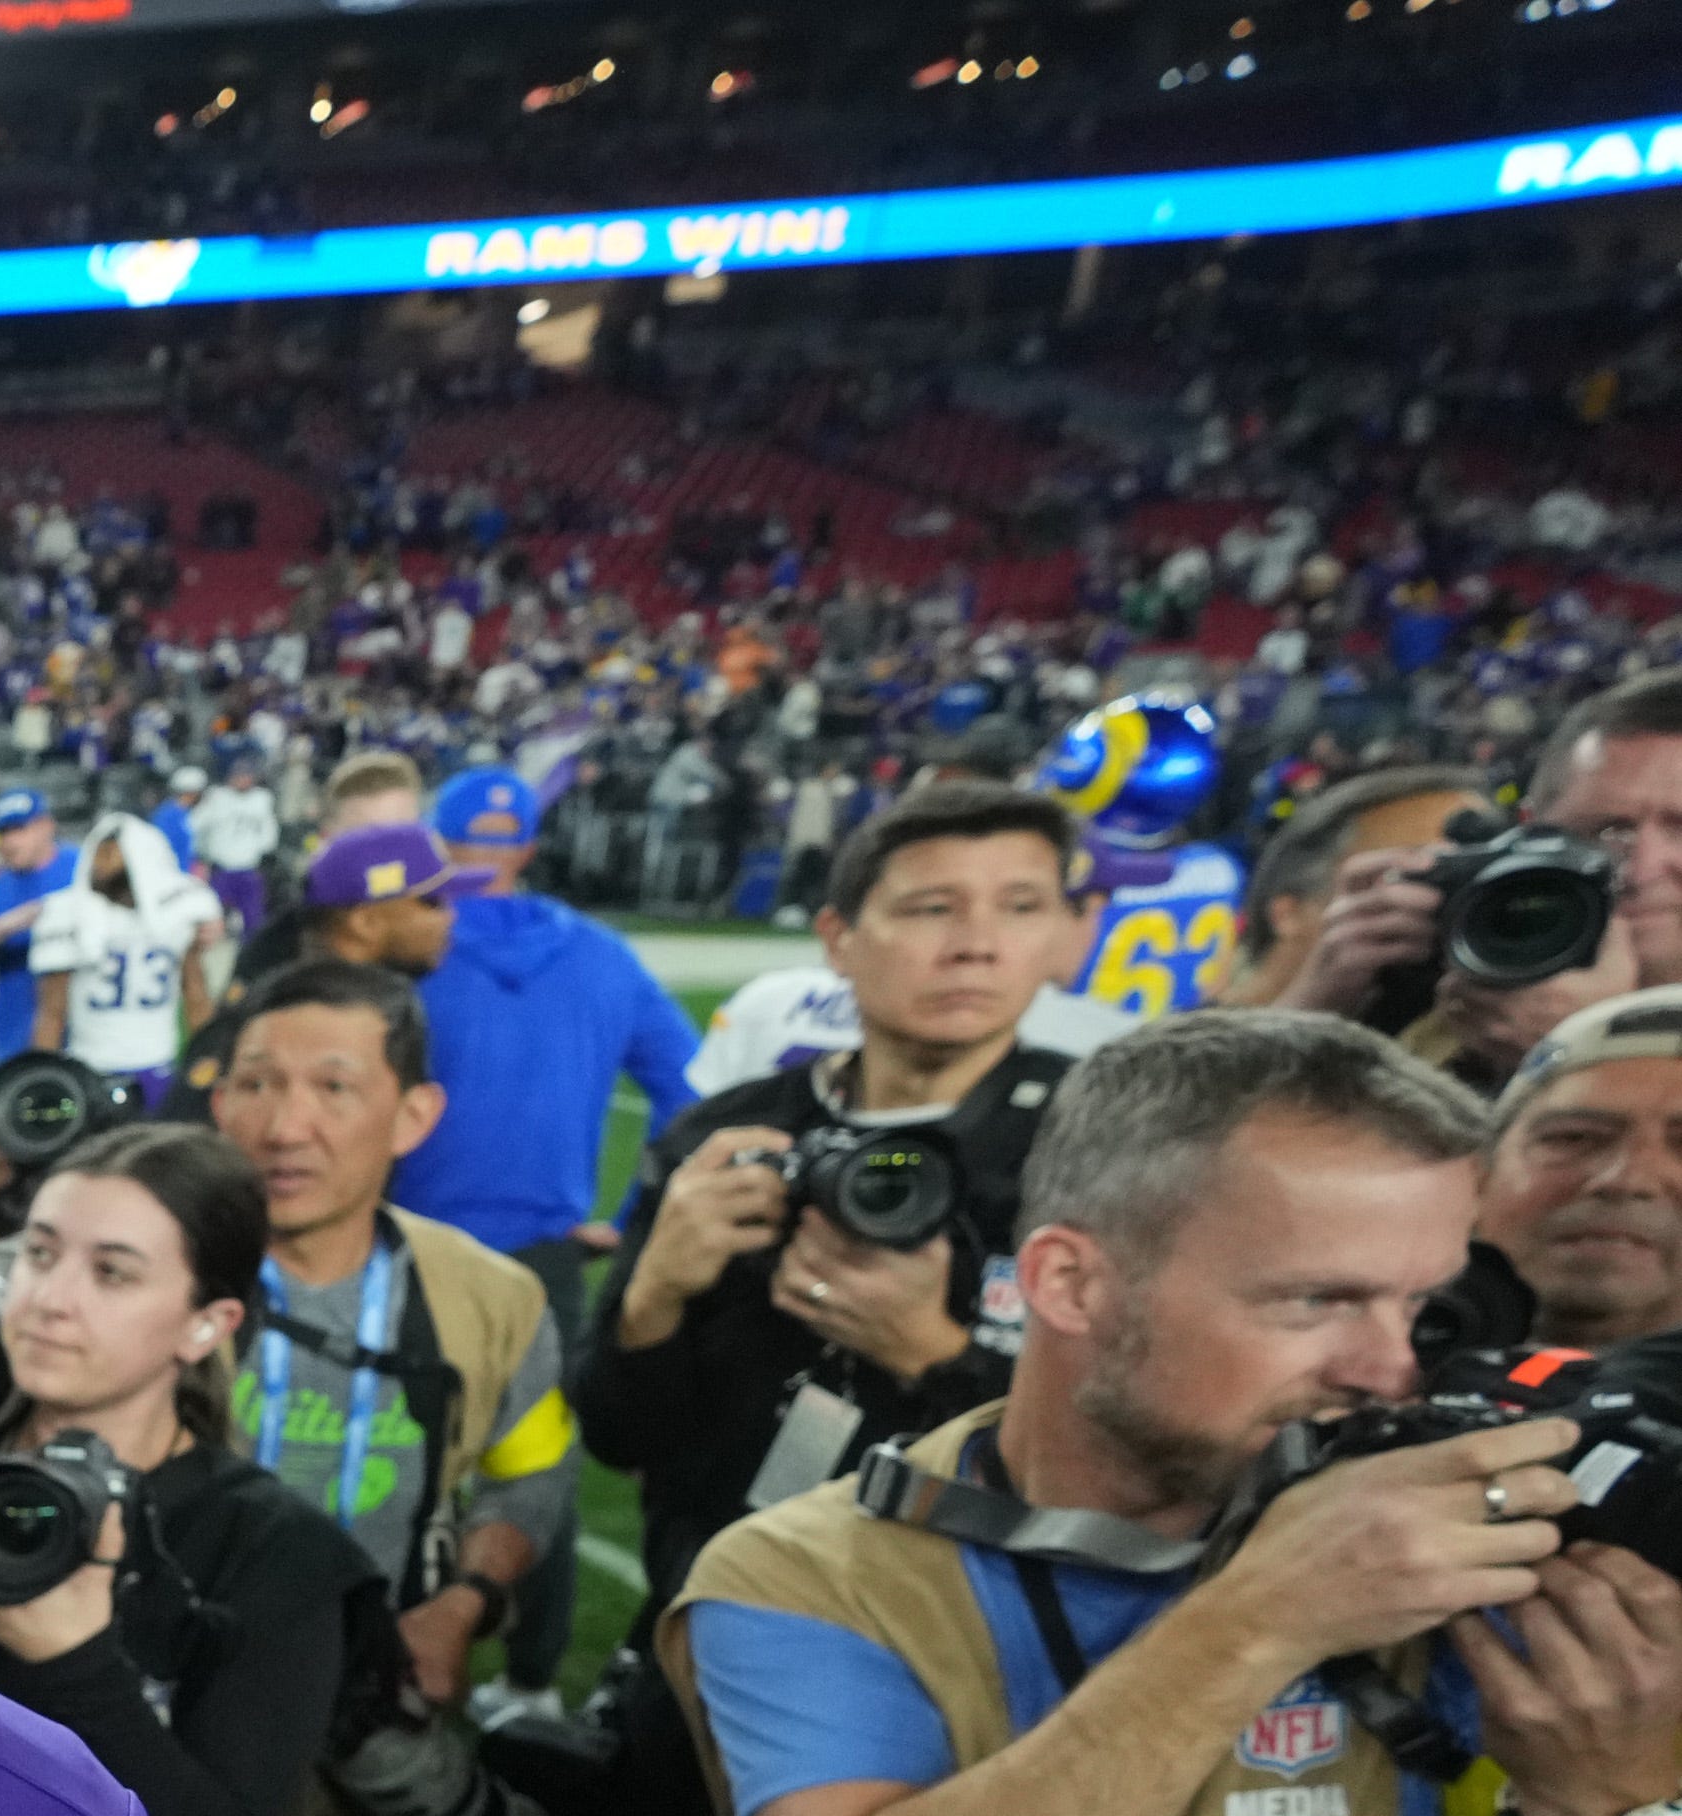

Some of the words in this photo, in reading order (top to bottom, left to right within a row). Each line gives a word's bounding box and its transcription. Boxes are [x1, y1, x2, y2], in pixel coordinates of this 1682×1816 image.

[426, 219, 646, 277] RAMS
[667, 205, 849, 263] WIN!
[88, 947, 181, 1010] 33
[1252, 1705, 1338, 1761] NFL
